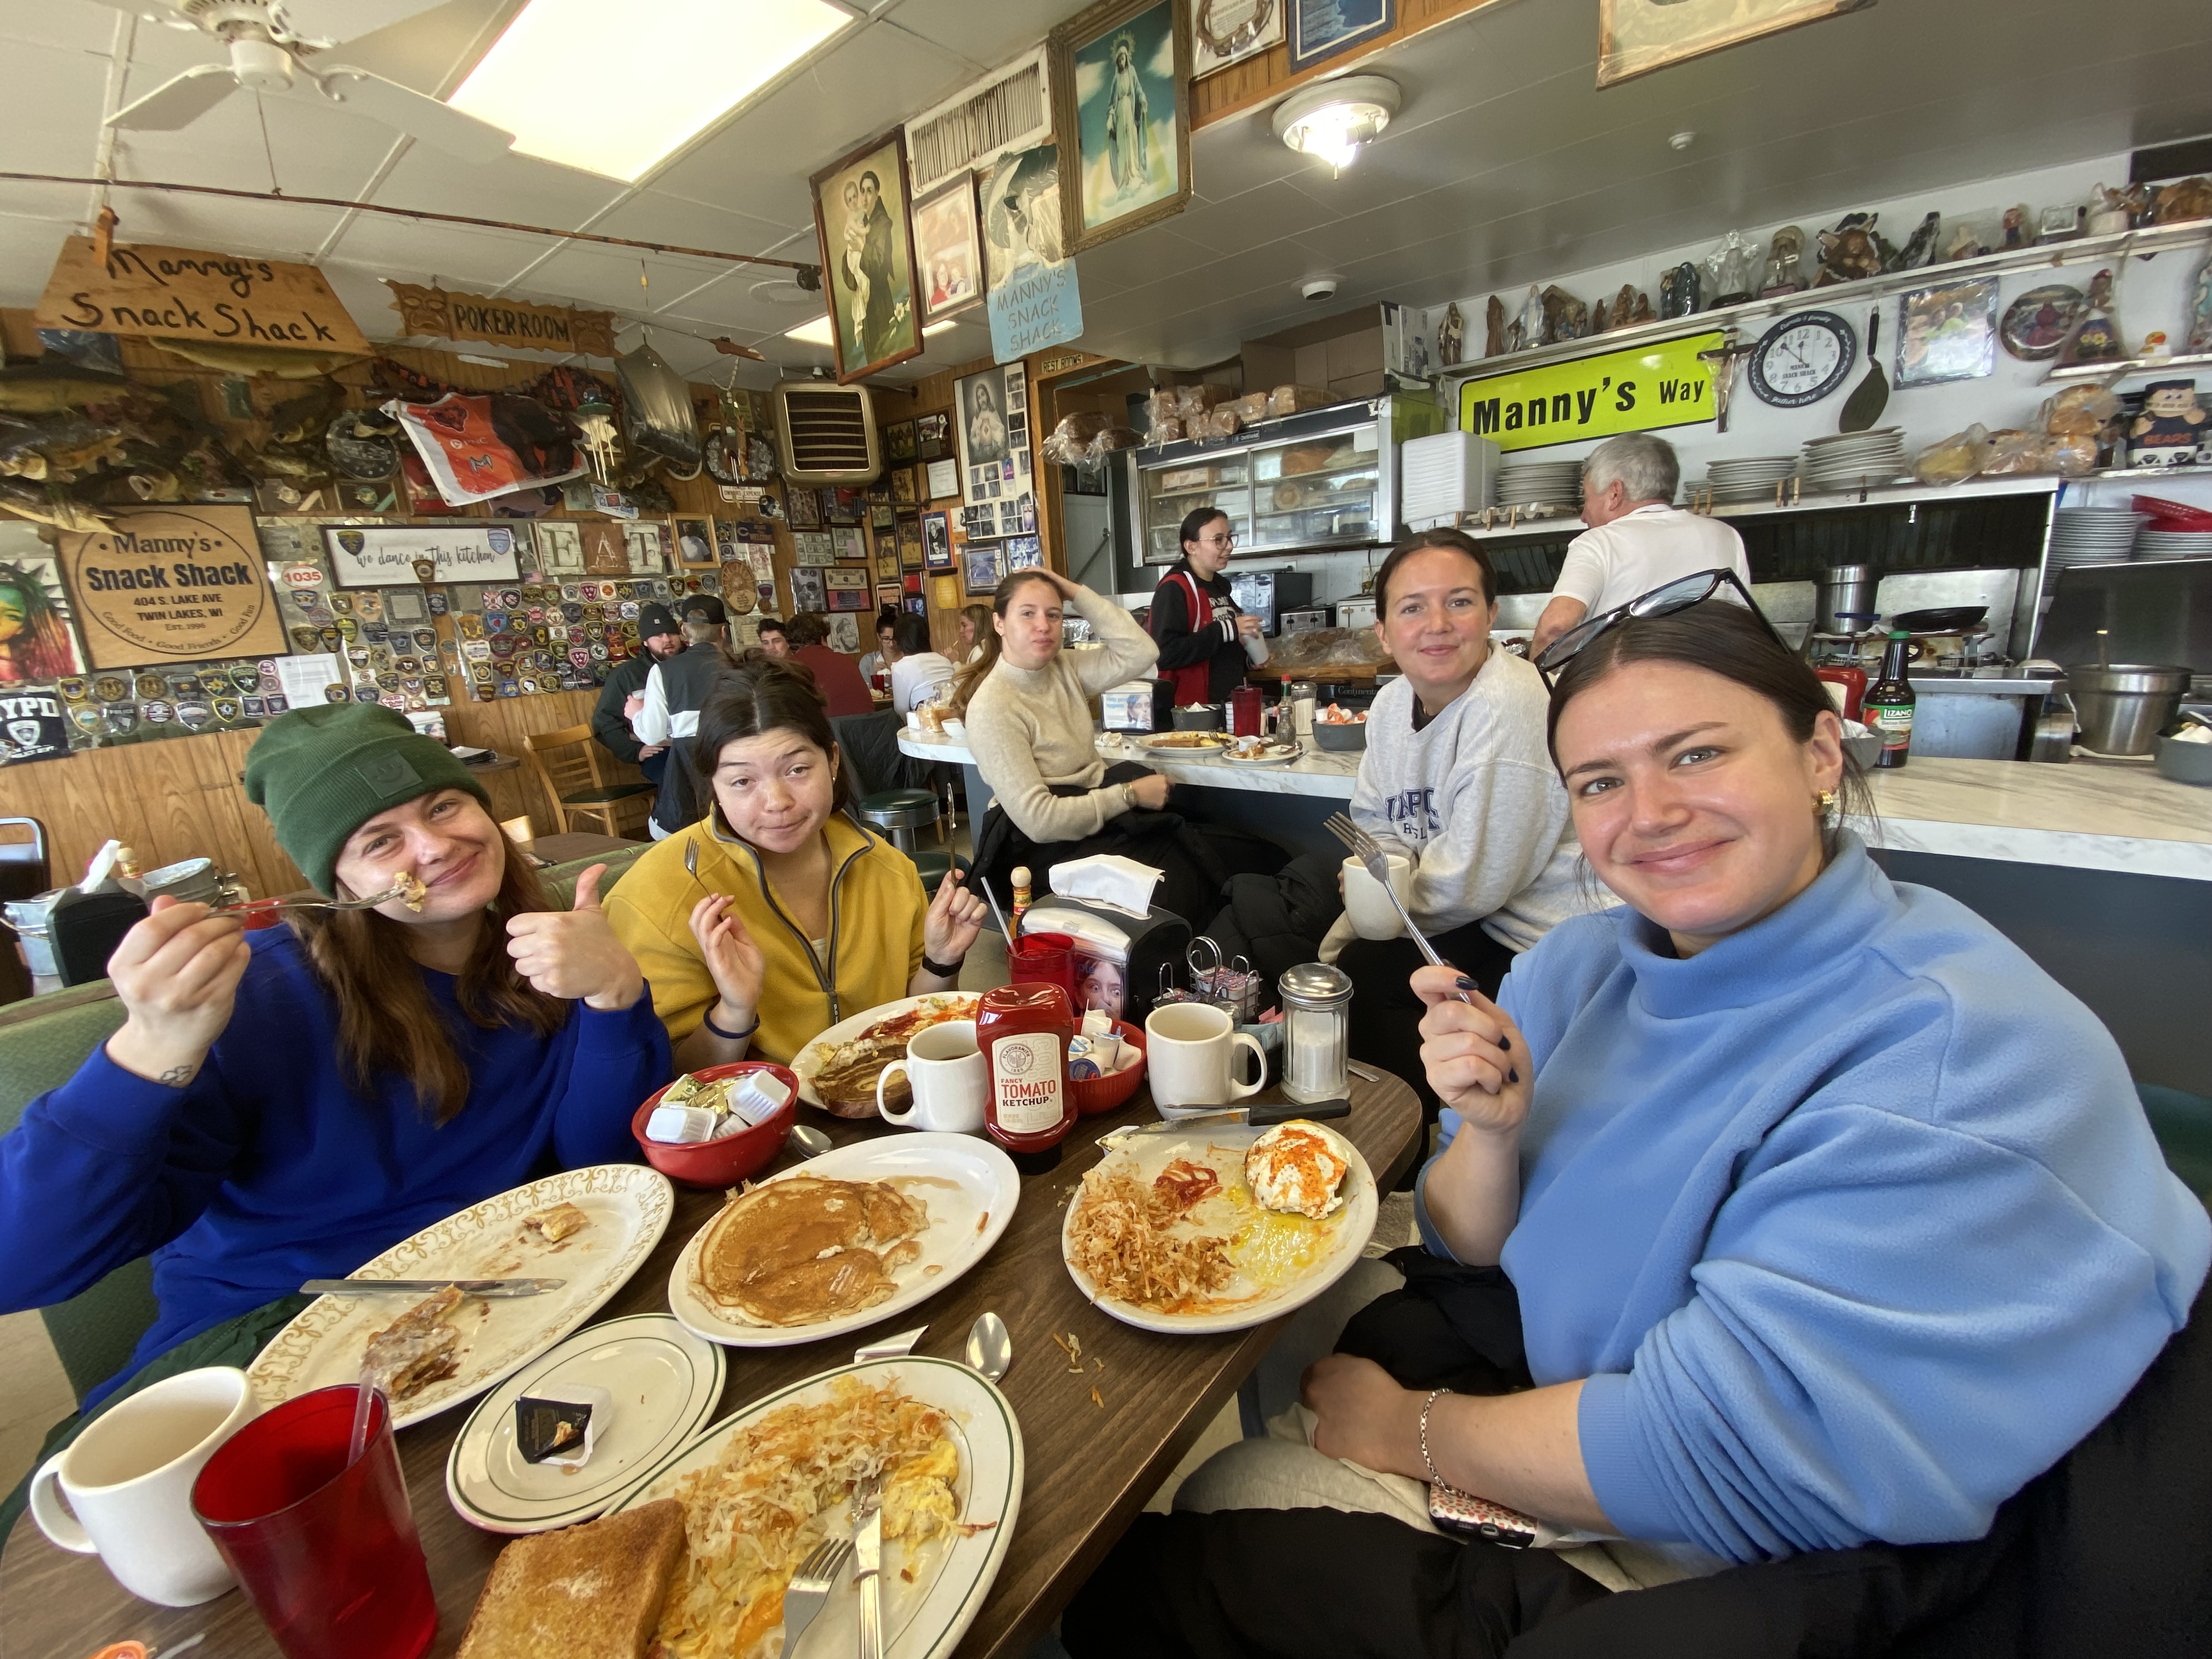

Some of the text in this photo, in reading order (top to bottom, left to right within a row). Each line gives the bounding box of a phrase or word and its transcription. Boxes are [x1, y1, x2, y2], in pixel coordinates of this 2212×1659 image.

[109, 249, 275, 298] Manny's
[997, 269, 1066, 313] MANNY'S
[62, 292, 336, 343] Snack Shack
[1008, 294, 1060, 330] SNACK
[454, 304, 569, 341] POKER ROOM
[1010, 317, 1062, 352] SHACK
[1796, 328, 1810, 340] 12
[1813, 330, 1821, 341] 1
[1824, 337, 1833, 348] 2
[1770, 346, 1784, 359] 10
[1043, 354, 1081, 373] REST ROOMS
[1765, 360, 1774, 371] 9
[1821, 364, 1830, 375] 4
[1768, 373, 1778, 383] 8
[1809, 376, 1818, 387] 5
[1780, 380, 1788, 392] 7
[1793, 382, 1802, 393] 6
[1472, 376, 1705, 435] Manny's Way
[112, 531, 212, 560] Manny's
[542, 528, 656, 568] EAT
[356, 555, 373, 568] we
[378, 546, 411, 566] dance
[424, 545, 453, 567] this
[455, 545, 495, 564] kitchen
[85, 562, 254, 591] Snack Shack
[284, 572, 321, 583] 1035
[133, 597, 156, 606] 404
[171, 595, 199, 605] LAKE
[201, 594, 223, 603] AVE
[136, 611, 167, 622] TWIN
[208, 608, 223, 617] WI
[0, 697, 60, 720] YPD
[1883, 708, 1912, 719] LIZANO
[1001, 1080, 1057, 1099] TOMATO
[1002, 1096, 1049, 1107] KETCHUP
